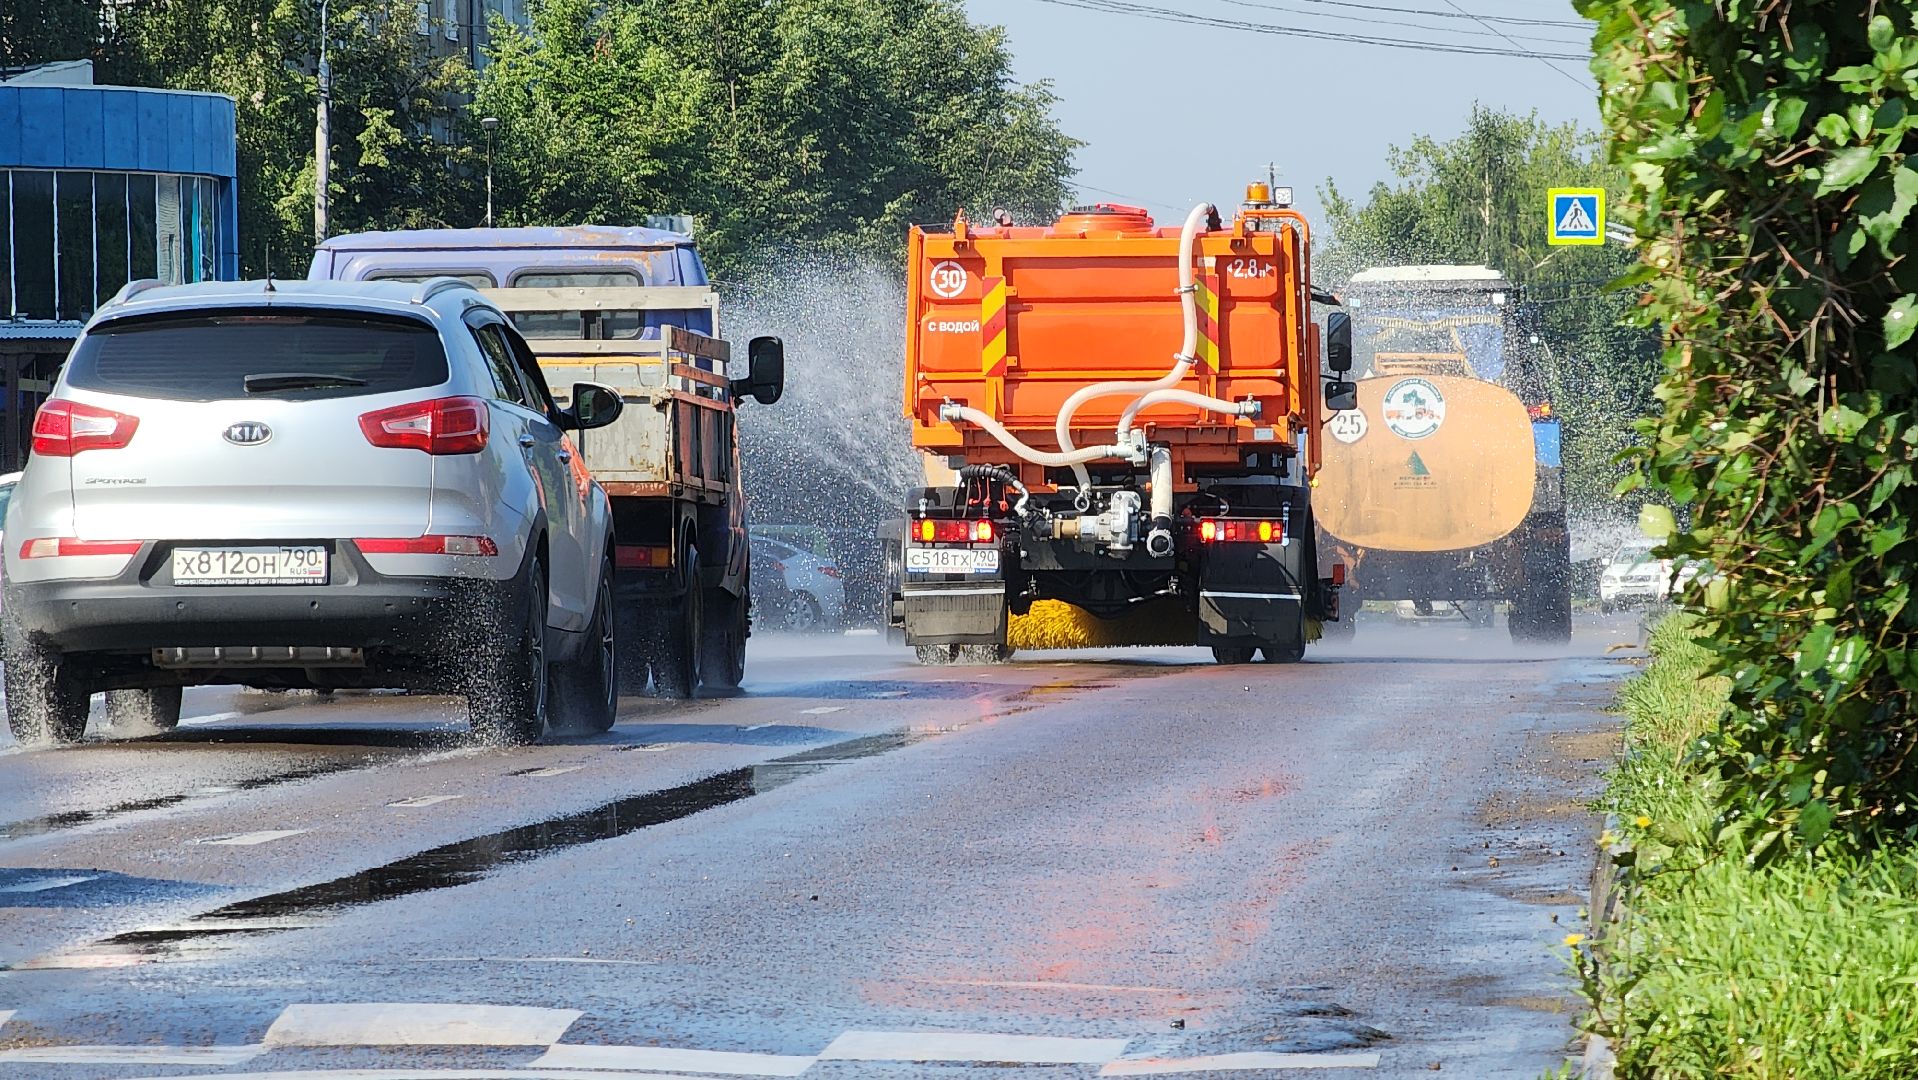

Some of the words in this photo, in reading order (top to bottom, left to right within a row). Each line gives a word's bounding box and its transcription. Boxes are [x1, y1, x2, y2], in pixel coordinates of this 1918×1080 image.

[938, 270, 961, 289] 30
[928, 321, 937, 332] С
[939, 319, 980, 334] ВОДОЙ
[1336, 414, 1362, 435] 25
[231, 425, 264, 441] KIA
[281, 548, 318, 567] 790
[971, 550, 995, 563] 790
[289, 567, 308, 576] RUS
